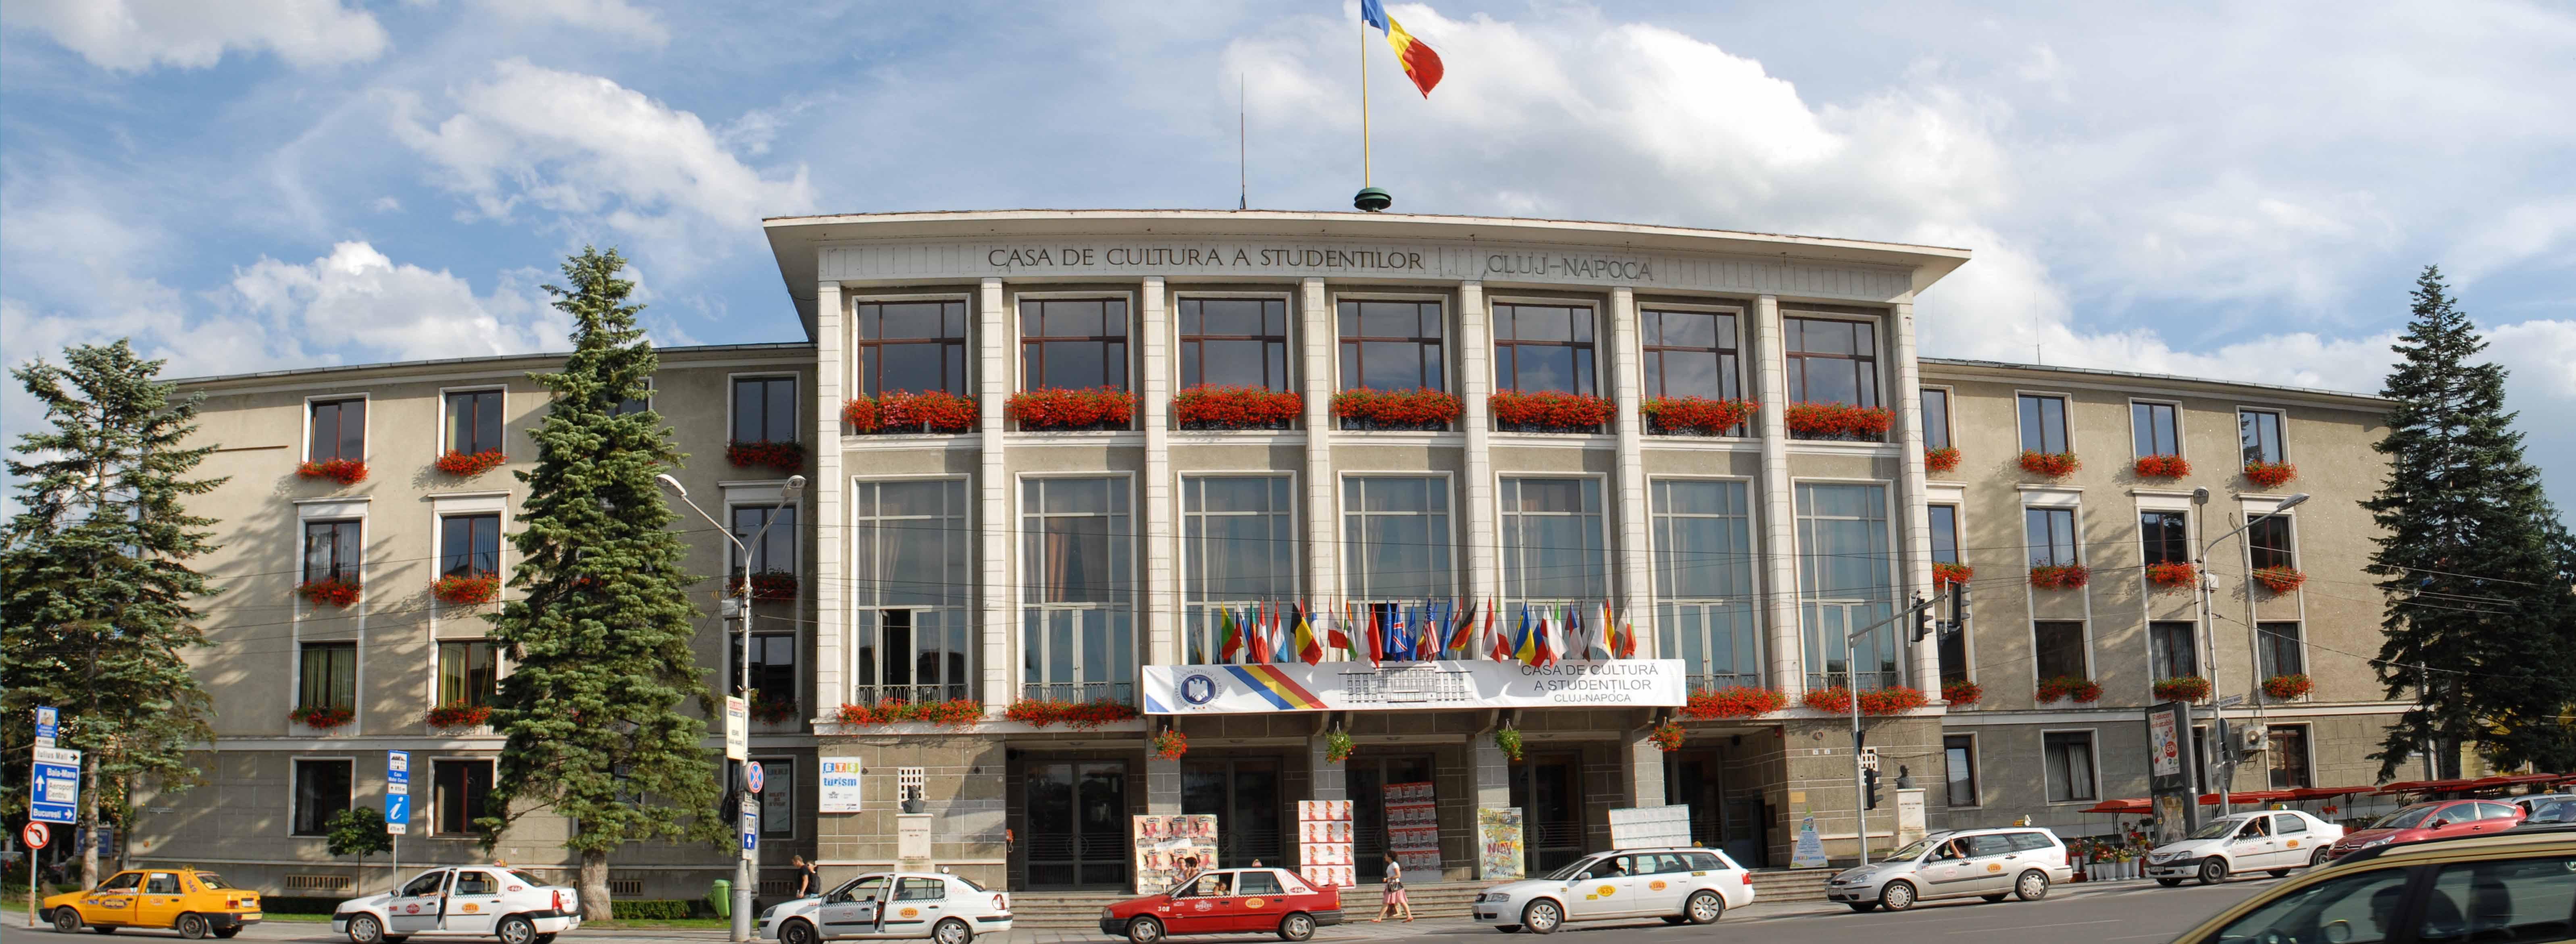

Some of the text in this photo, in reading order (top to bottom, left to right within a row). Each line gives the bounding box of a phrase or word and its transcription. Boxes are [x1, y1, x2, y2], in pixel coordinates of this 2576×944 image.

[988, 248, 1424, 270] CASA DE CULTURA A STUDENTILOR
[1521, 663, 1658, 676] CASA DE CULTURĂ
[1534, 680, 1544, 691] A
[1554, 693, 1631, 703] CLUJ-NAPOCA
[823, 777, 857, 786] turism
